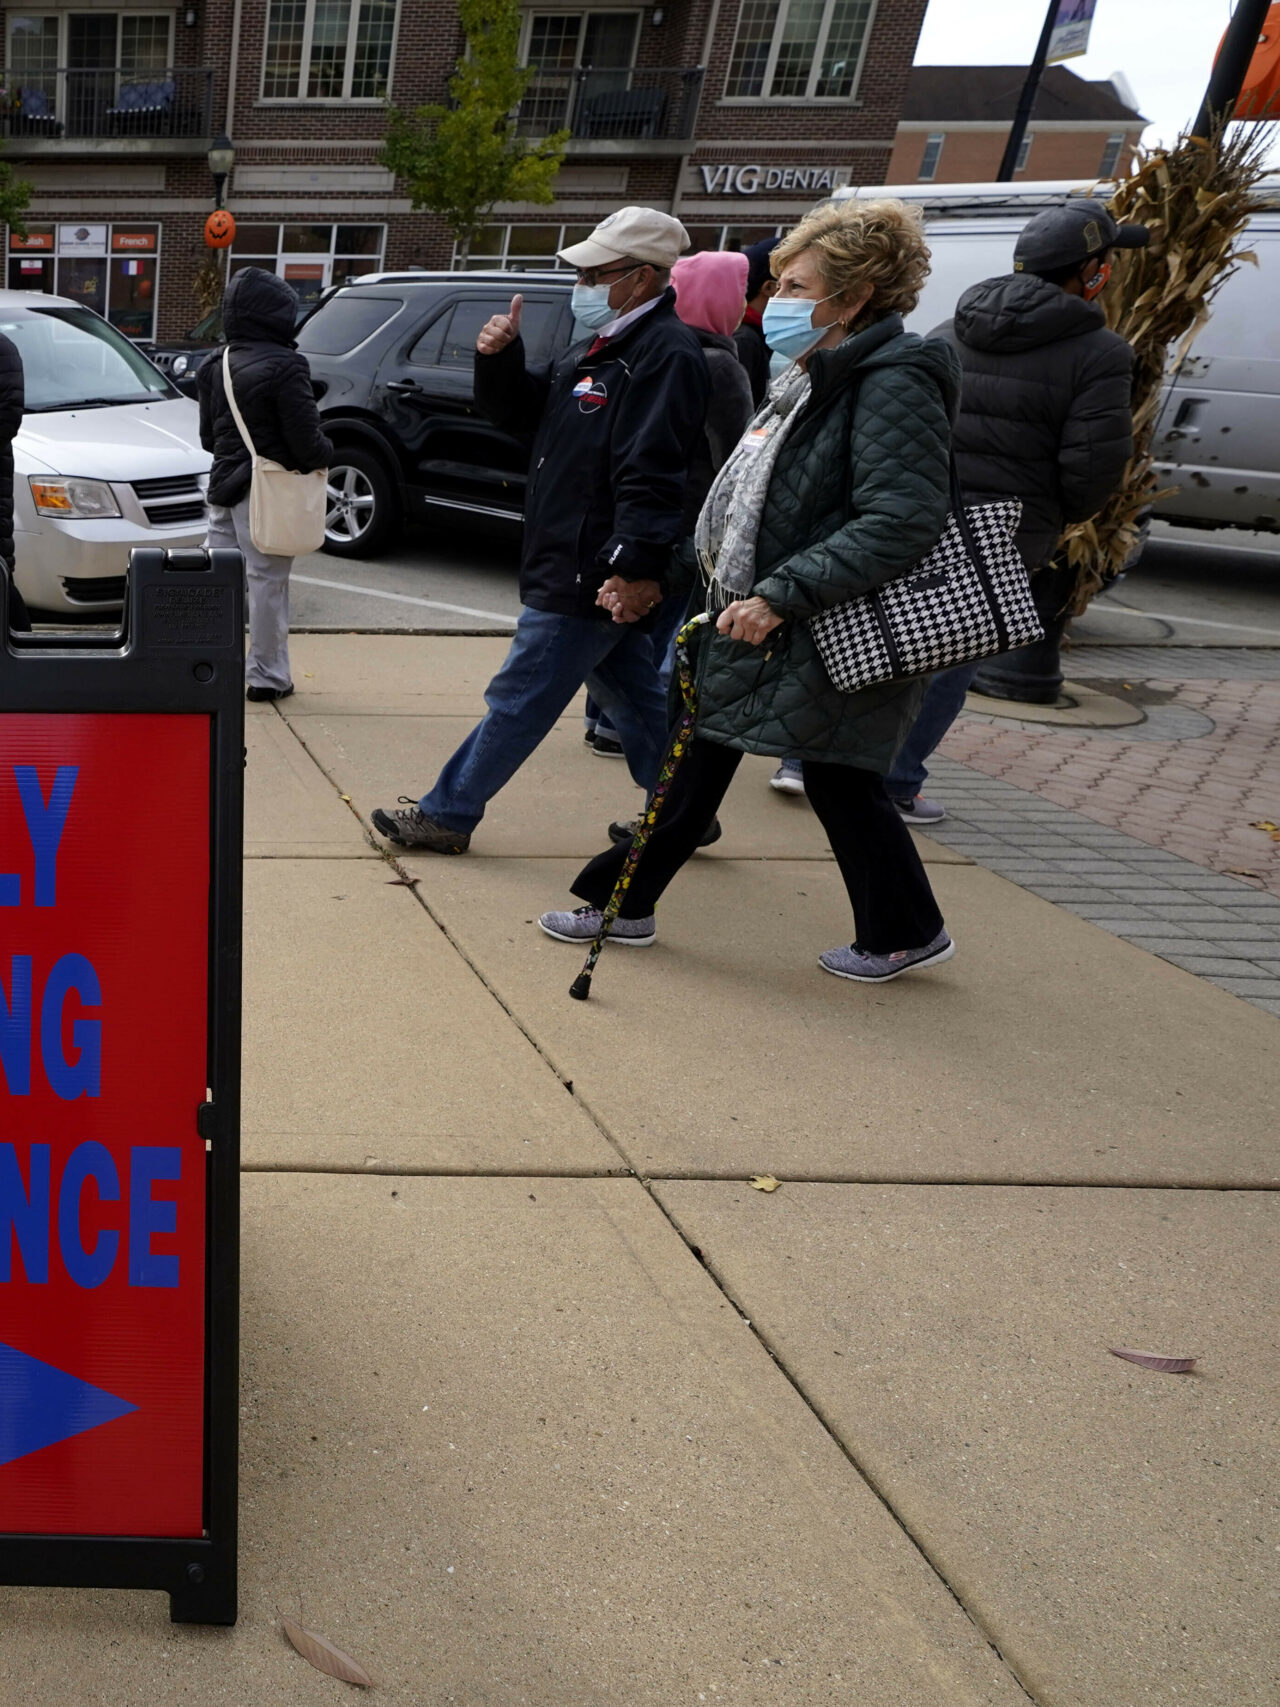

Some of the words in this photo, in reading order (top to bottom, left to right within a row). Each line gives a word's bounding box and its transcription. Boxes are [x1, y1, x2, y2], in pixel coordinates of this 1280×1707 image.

[700, 165, 762, 194] VIG
[765, 168, 838, 190] DENTAL
[119, 237, 148, 246] French
